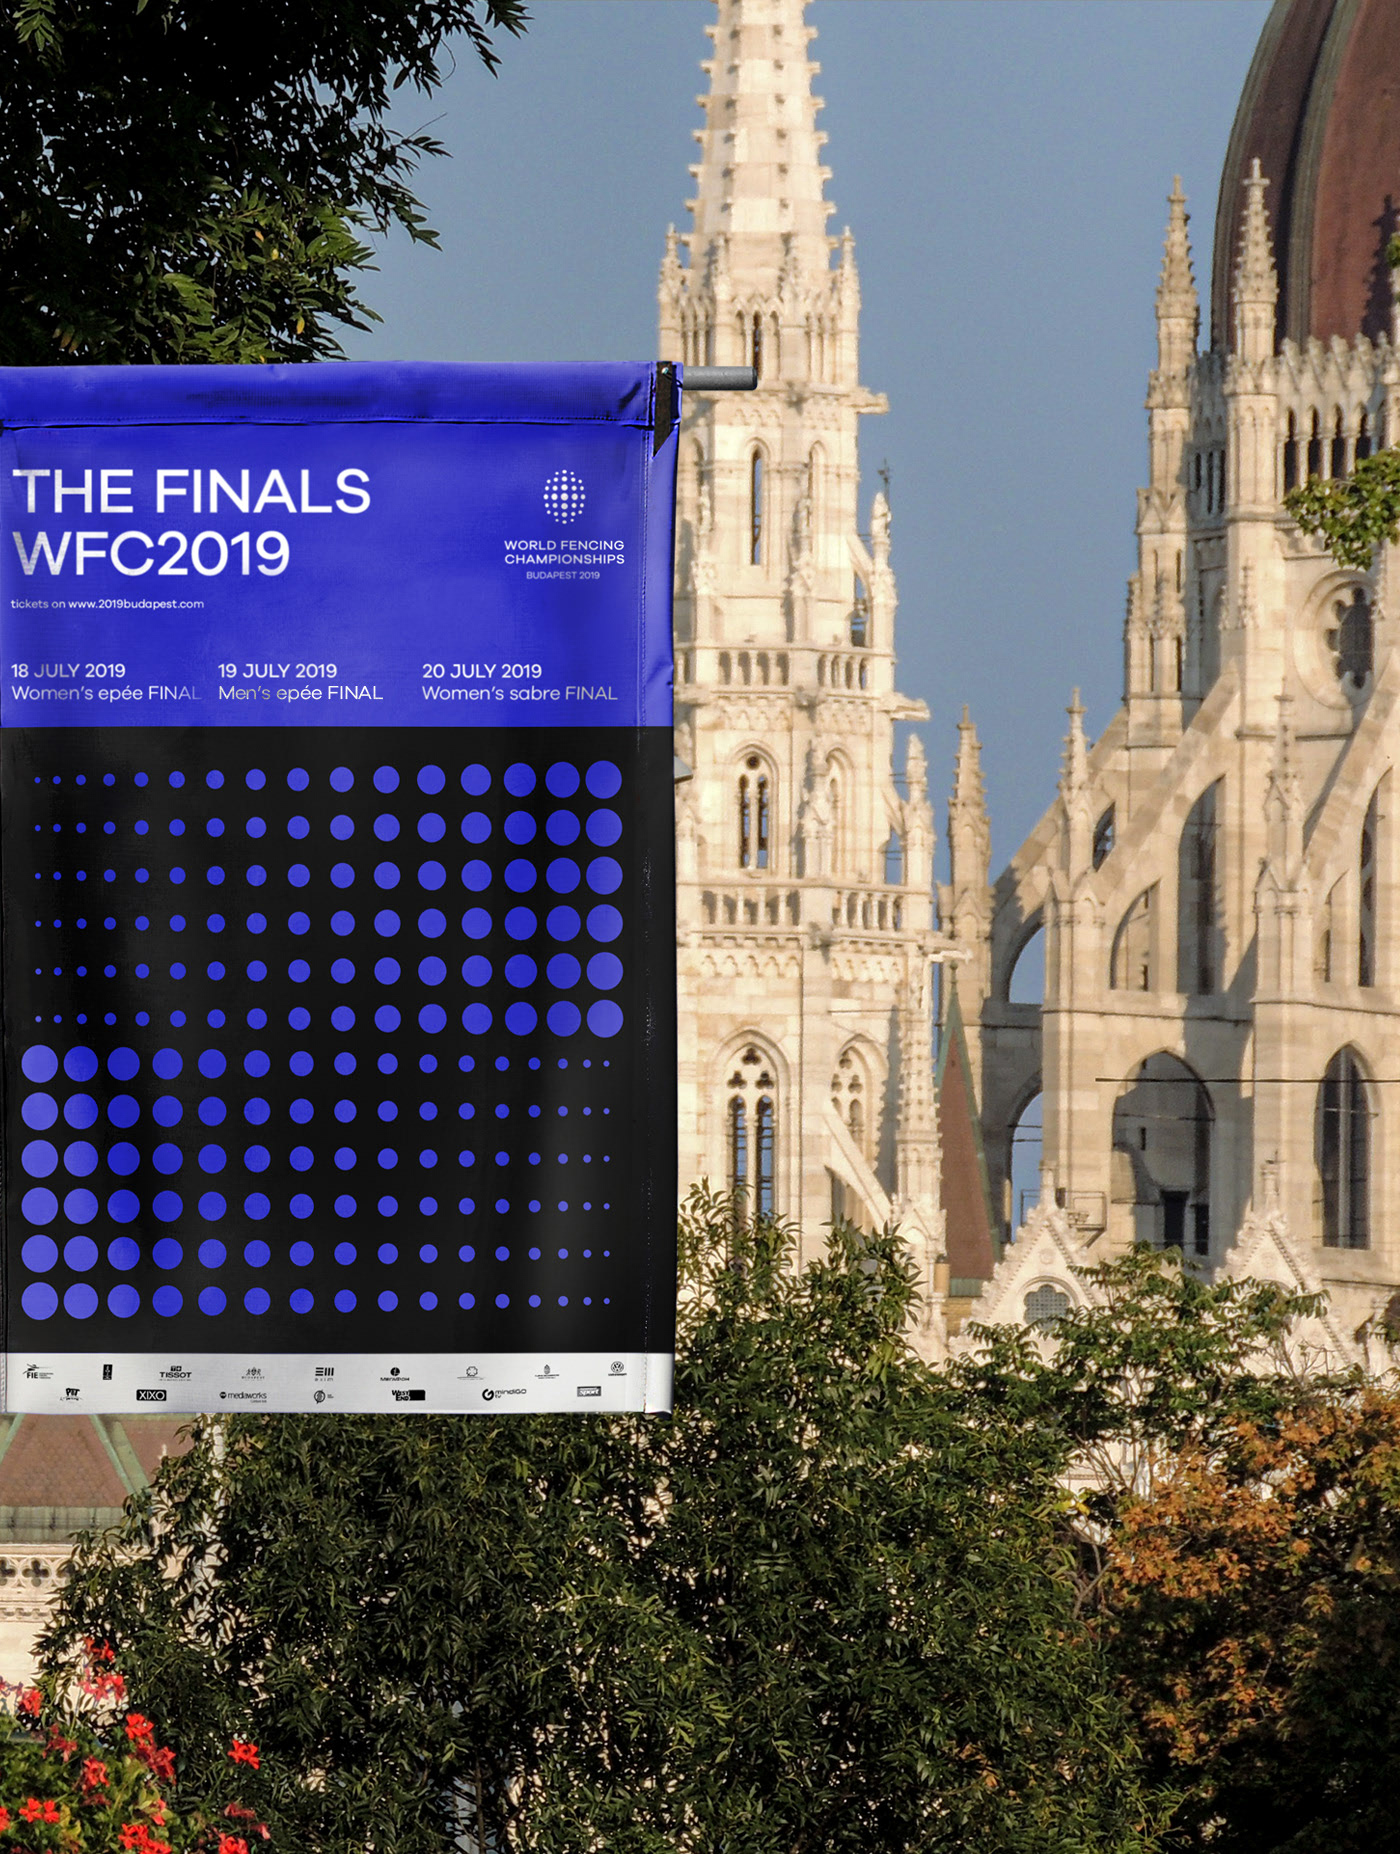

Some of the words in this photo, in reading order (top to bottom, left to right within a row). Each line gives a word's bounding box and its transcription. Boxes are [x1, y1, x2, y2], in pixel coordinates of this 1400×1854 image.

[13, 469, 133, 513] THE
[157, 468, 370, 514] FINALS
[503, 539, 557, 551] WORLD
[560, 540, 625, 551] FENCING
[13, 531, 289, 576] WFC2019
[504, 553, 625, 565] CHAMPIONSHIPS
[526, 570, 577, 580] BUDAPEST
[579, 570, 601, 580] 2019
[10, 598, 49, 609] tickets
[51, 600, 66, 609] on
[67, 598, 205, 611] www.2019budapest.com
[11, 664, 28, 678] 18
[34, 664, 80, 677] JULY
[86, 664, 125, 677] 2019
[218, 664, 237, 678] 19
[243, 664, 290, 678] JULY
[296, 664, 337, 678] 2019
[423, 664, 445, 678] 20
[450, 664, 496, 678] JULY
[502, 664, 542, 678] 2019
[99, 685, 143, 702] epée
[148, 685, 201, 700] FINAL
[277, 685, 322, 702] epée
[328, 686, 383, 699] FINAL
[510, 686, 560, 700] sabre
[566, 686, 618, 700] FINAL
[138, 1390, 165, 1401] XIXO
[227, 1391, 267, 1399] mediaworks
